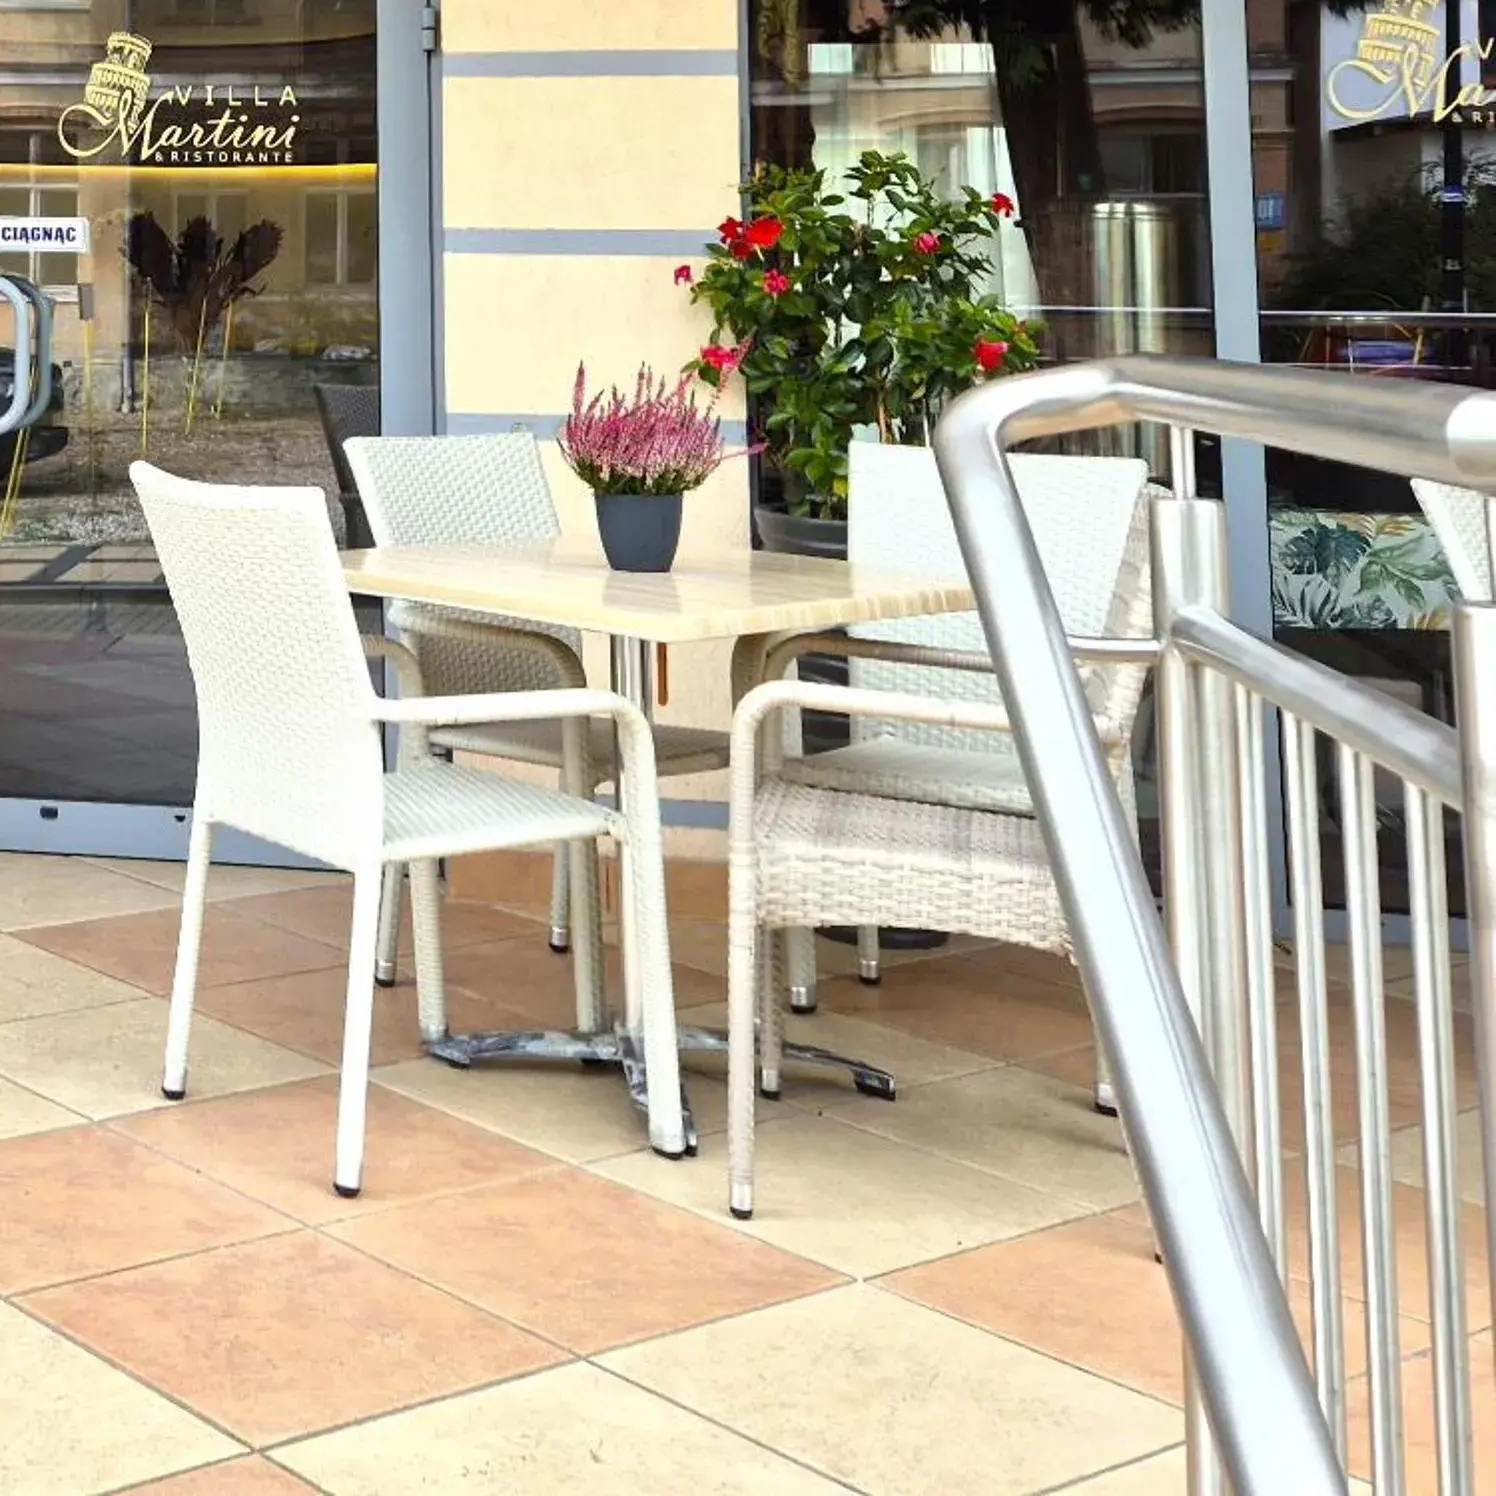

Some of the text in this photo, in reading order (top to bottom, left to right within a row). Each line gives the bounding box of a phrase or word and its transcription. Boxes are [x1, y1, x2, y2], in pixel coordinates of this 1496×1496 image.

[175, 85, 298, 106] VILLA
[58, 89, 300, 160] Martini
[154, 151, 293, 163] & RISTORANTE
